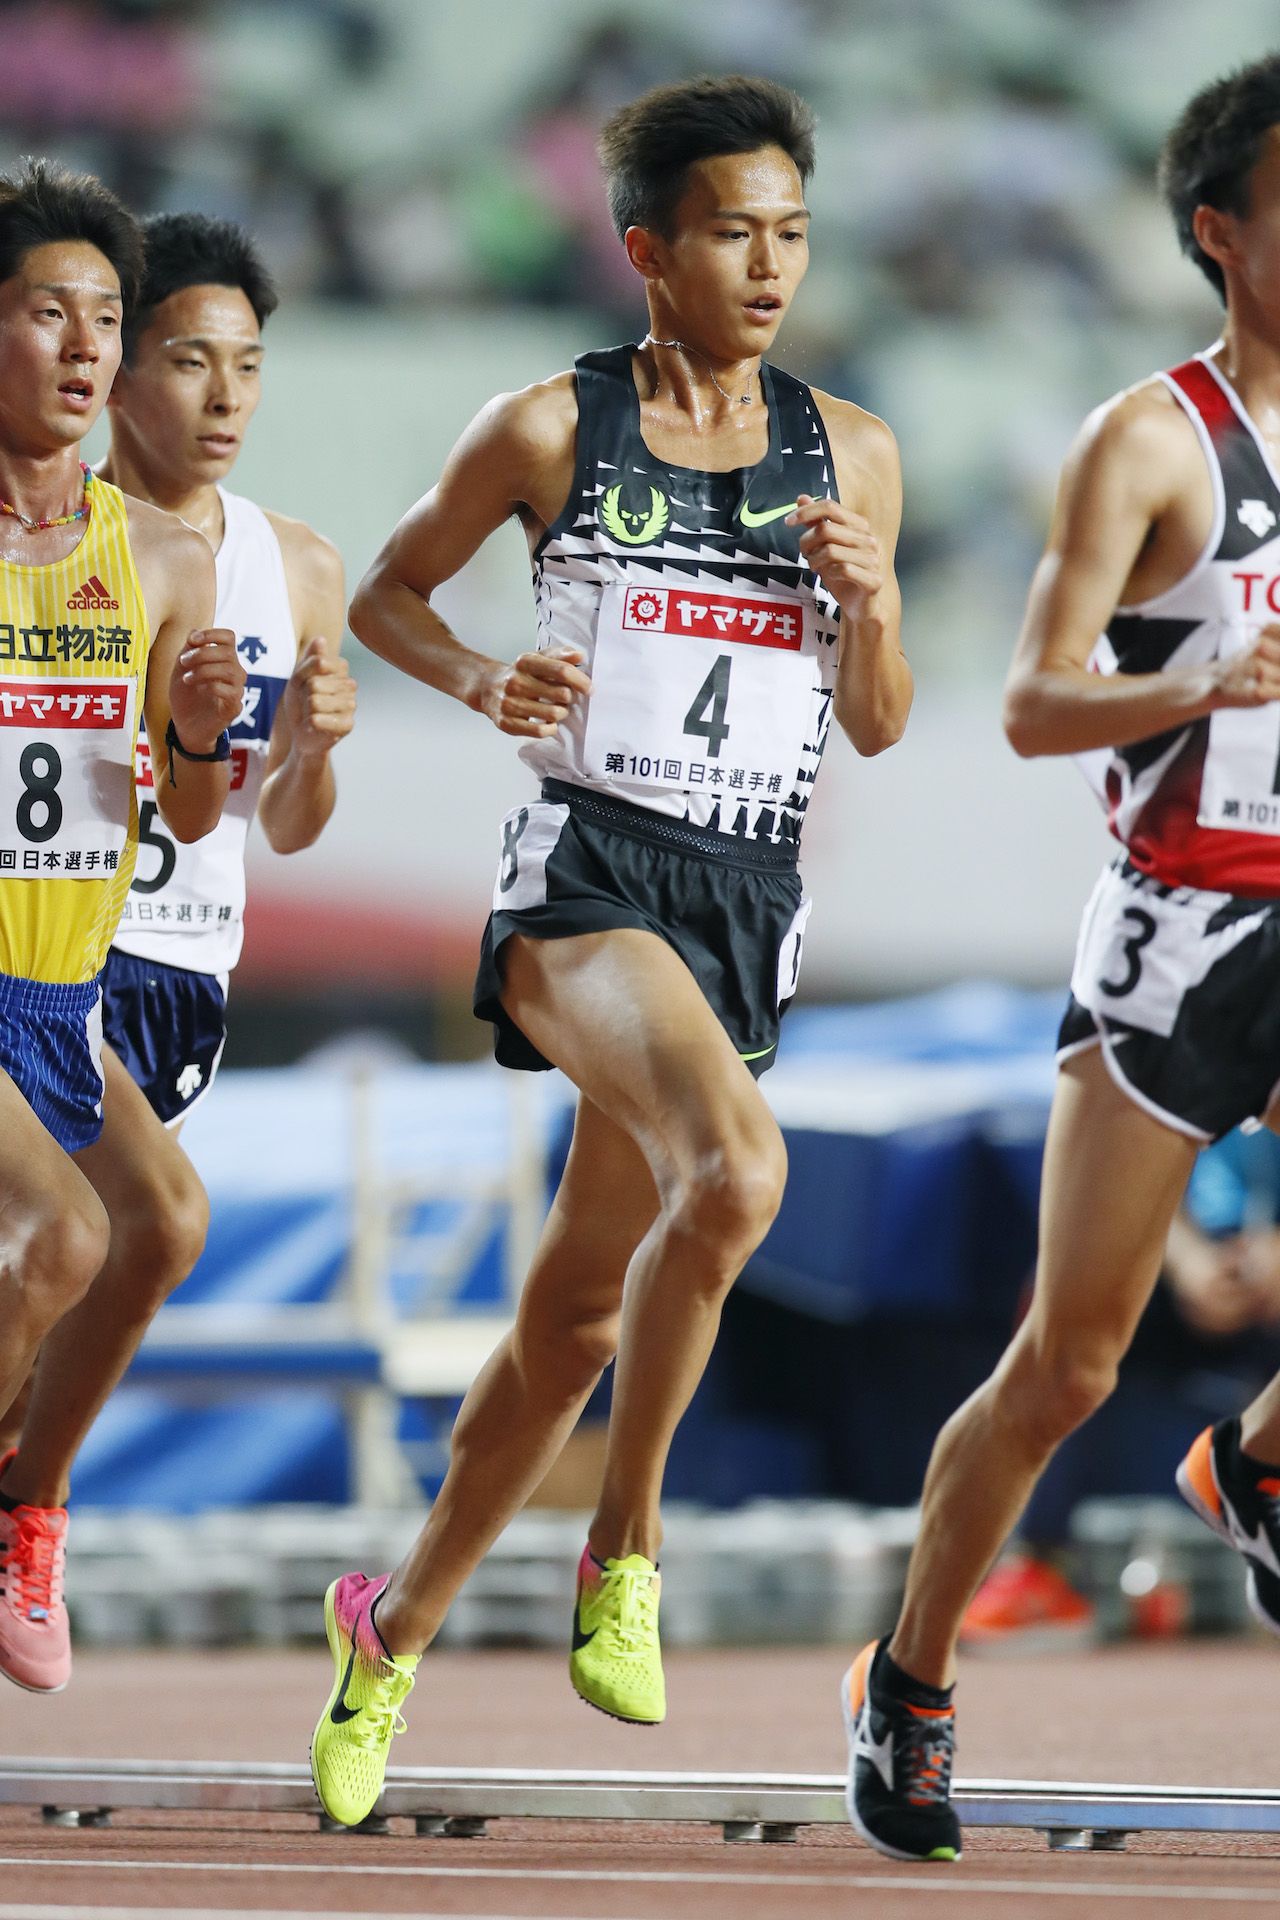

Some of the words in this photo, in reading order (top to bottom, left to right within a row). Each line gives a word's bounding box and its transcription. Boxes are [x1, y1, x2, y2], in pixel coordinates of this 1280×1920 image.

[66, 597, 120, 610] adidas
[676, 600, 797, 640] ヤマザキ
[0, 692, 121, 720] ヤマザキ
[682, 654, 733, 759] 4
[16, 742, 63, 843] 8
[130, 800, 177, 894] 5
[500, 806, 529, 894] 8
[1099, 907, 1157, 998] 3
